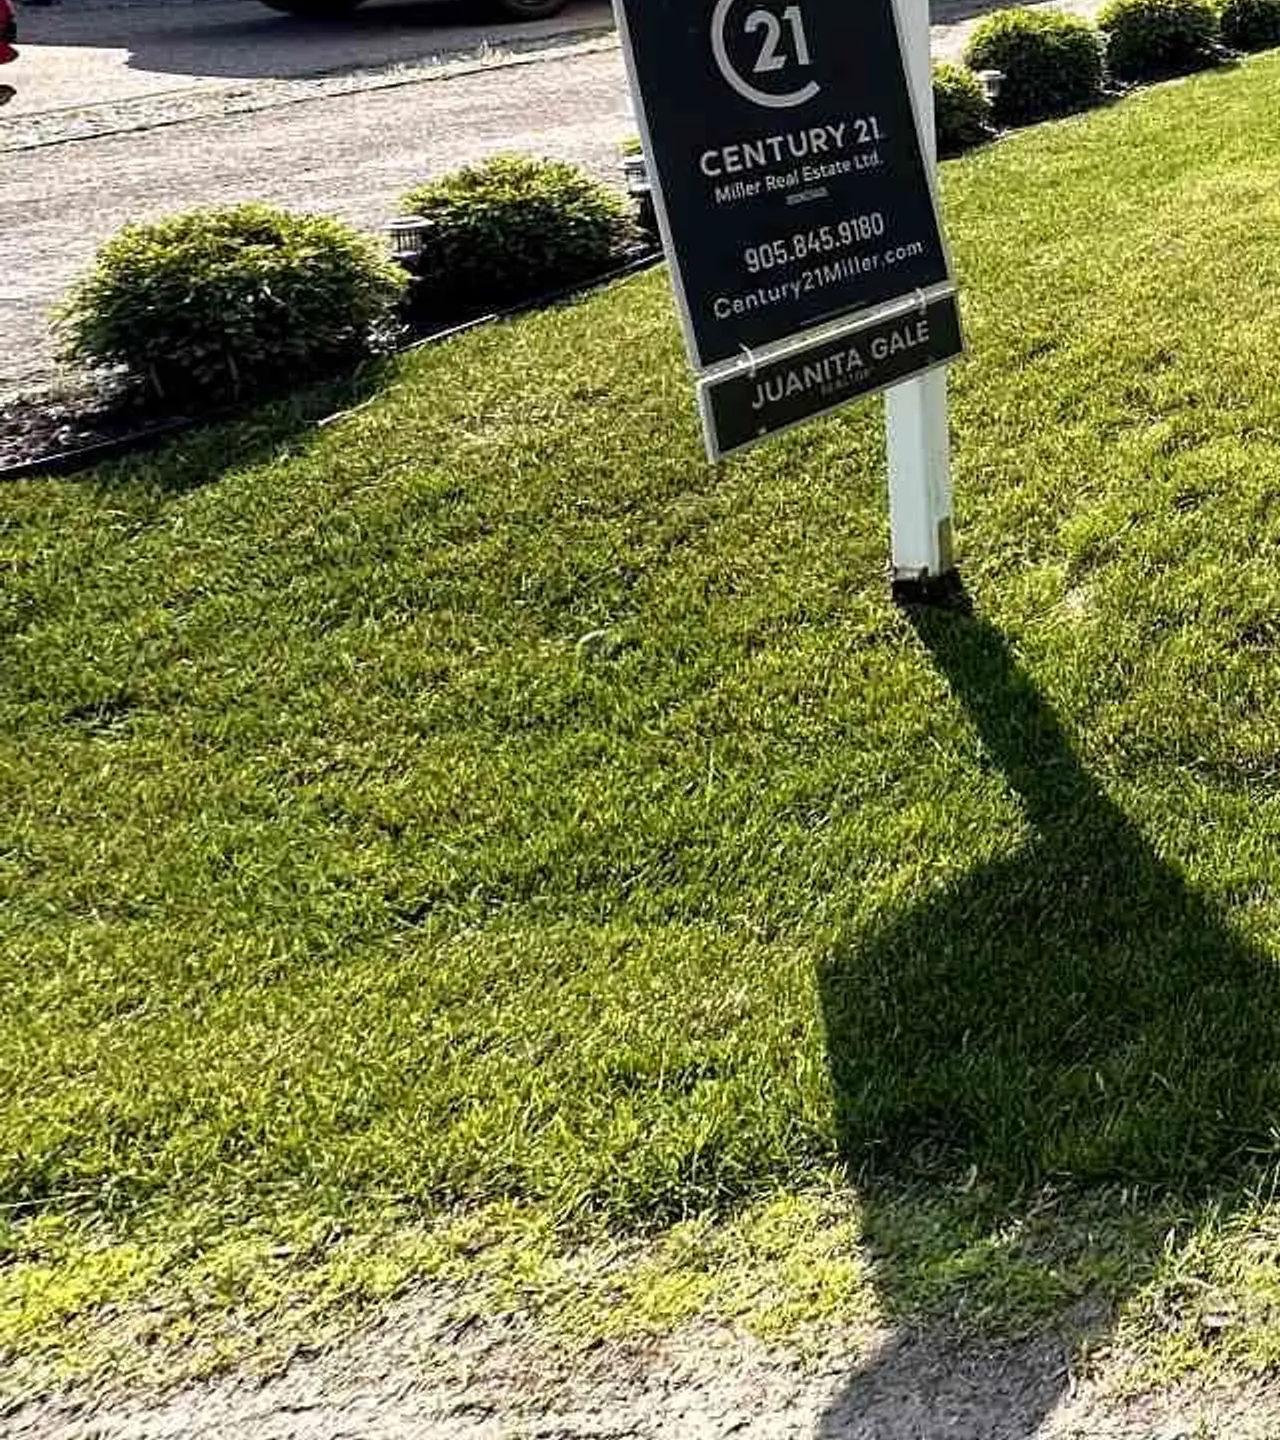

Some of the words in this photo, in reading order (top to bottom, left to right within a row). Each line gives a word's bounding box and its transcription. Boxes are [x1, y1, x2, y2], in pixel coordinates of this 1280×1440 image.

[700, 122, 845, 176] CENTURY
[854, 116, 880, 143] 21
[714, 181, 761, 204] Miller
[765, 169, 799, 191] Real
[802, 160, 850, 181] Estate
[854, 151, 883, 170] Ltd.
[744, 212, 884, 273] 905.845.9180
[713, 240, 924, 319] Century21Miller.com
[752, 348, 863, 409] JUANITA
[871, 320, 930, 360] GALE
